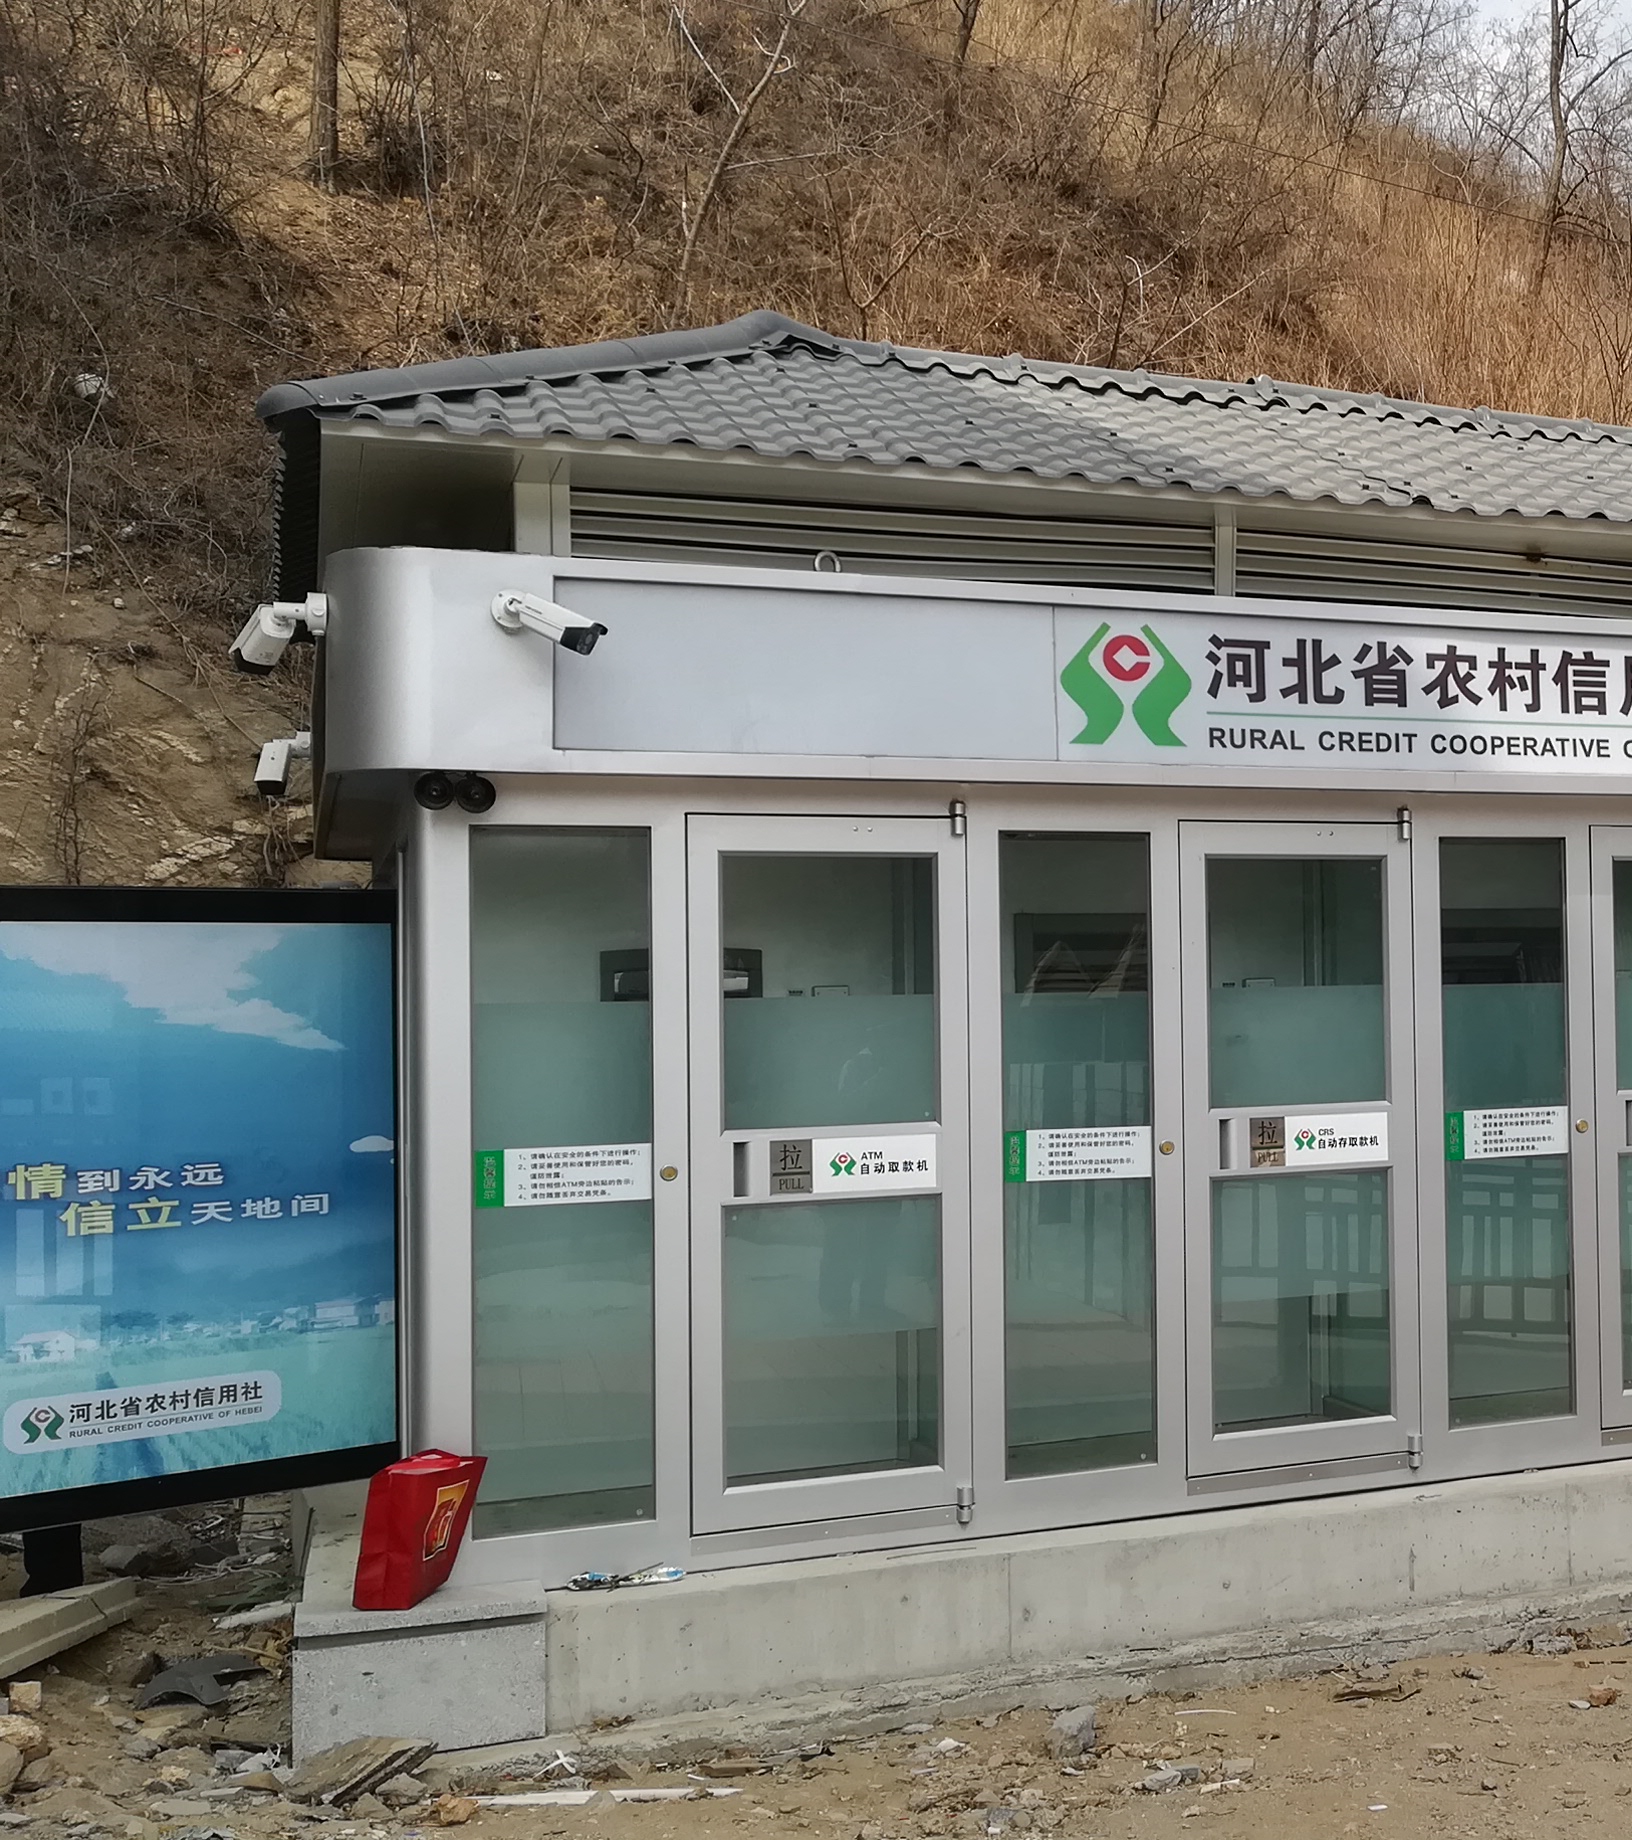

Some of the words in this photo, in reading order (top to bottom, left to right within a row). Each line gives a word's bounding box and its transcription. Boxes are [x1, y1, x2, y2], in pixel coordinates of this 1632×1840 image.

[1208, 727, 1305, 751] RURAL
[1318, 730, 1418, 753] CREDIT
[1430, 734, 1611, 759] COOPERATIVE
[1258, 1120, 1278, 1145] 拉
[1317, 1135, 1380, 1150] 自动存取款机
[1318, 1128, 1335, 1136] CRS
[779, 1144, 803, 1171] 拉
[860, 1160, 928, 1175] 自动取款机
[861, 1151, 883, 1160] ATM
[7, 1162, 225, 1200] 情到永远
[779, 1178, 804, 1190] PULL
[59, 1192, 330, 1237] 信立天地间
[69, 1381, 263, 1424] 河北省农村信用社
[69, 1428, 103, 1438] RURAL
[107, 1422, 143, 1434] CREDIT
[147, 1412, 214, 1428] COOPERATIVE
[218, 1409, 231, 1418] OF
[235, 1406, 263, 1416] HEBEI
